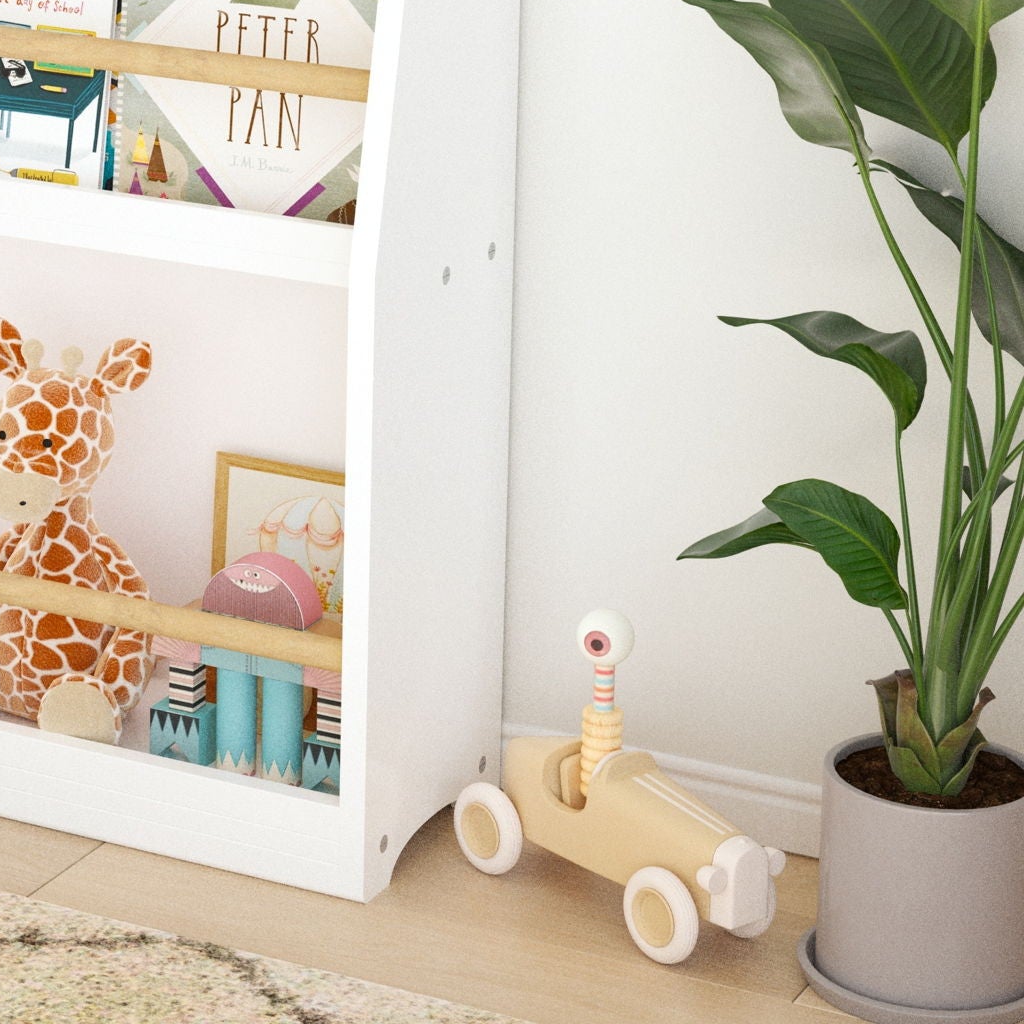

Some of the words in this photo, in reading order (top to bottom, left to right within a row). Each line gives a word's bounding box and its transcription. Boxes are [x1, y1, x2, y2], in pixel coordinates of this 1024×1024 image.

[37, 0, 49, 11] of
[216, 9, 320, 65] PETER
[226, 86, 304, 151] PAN
